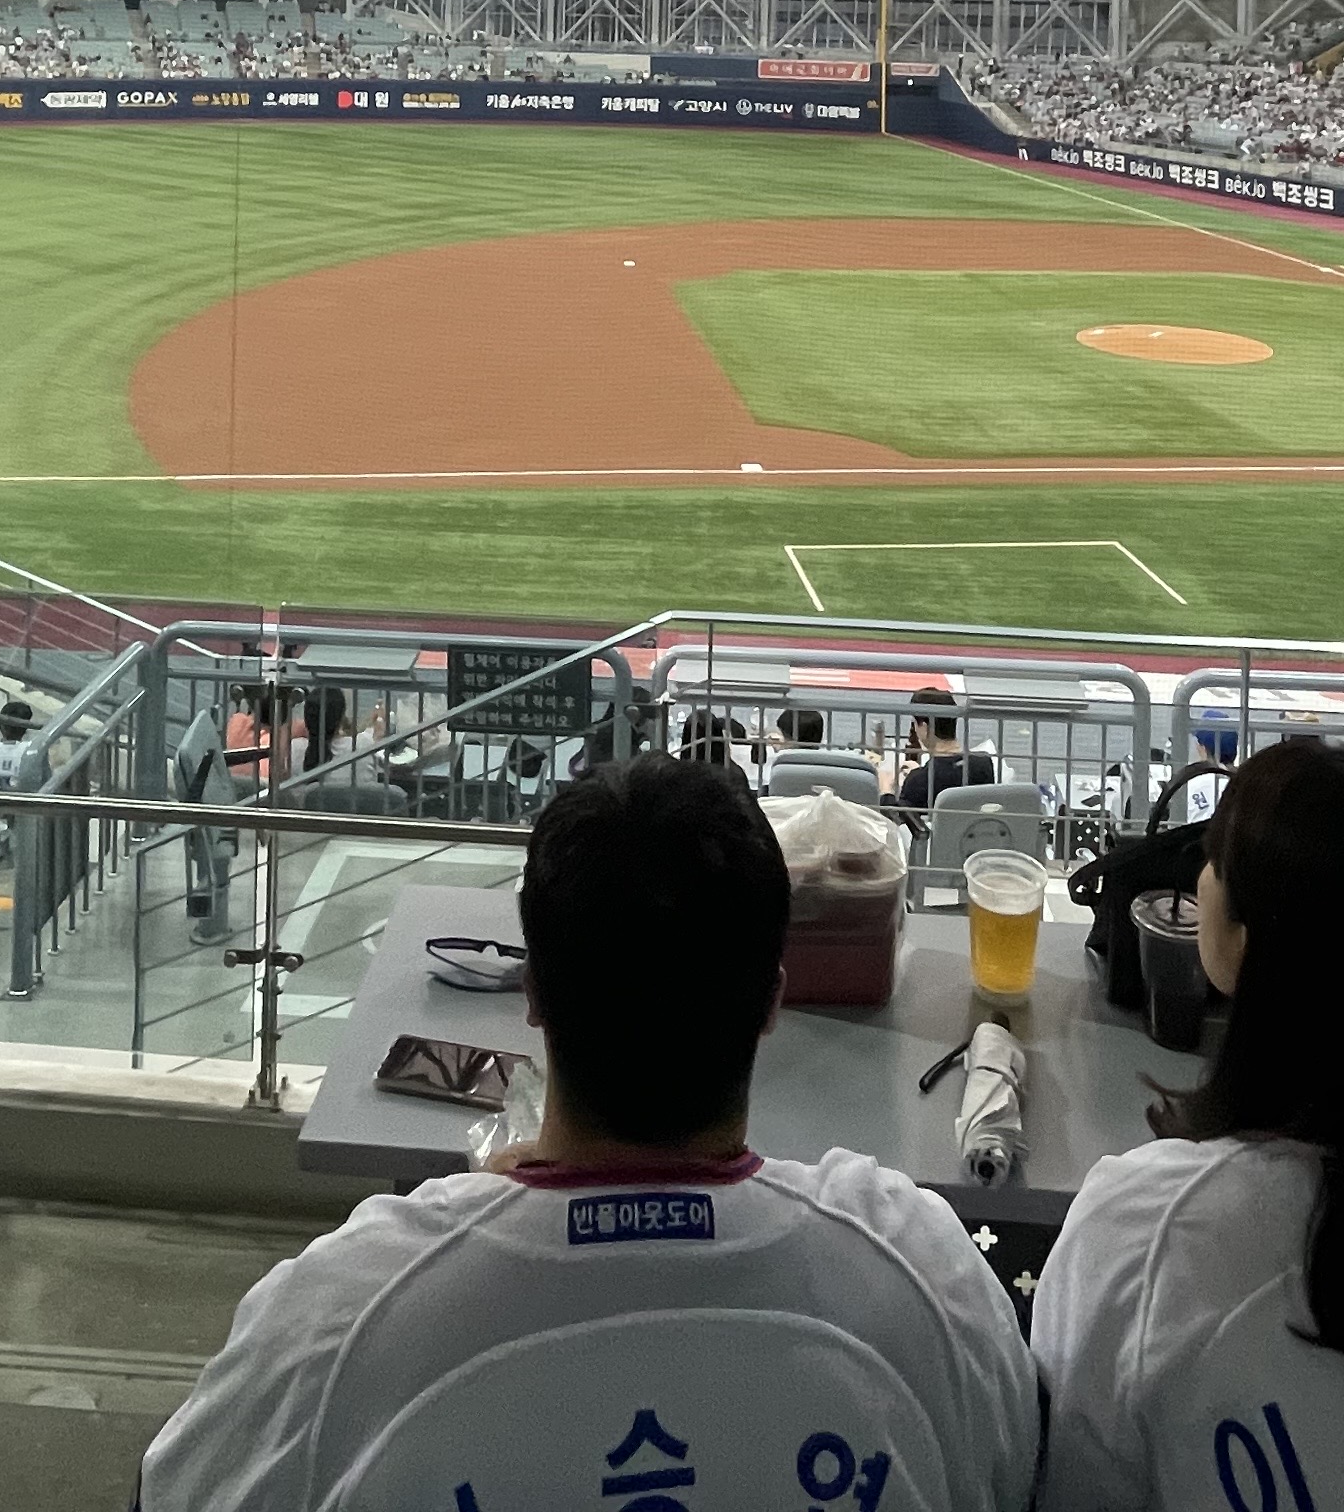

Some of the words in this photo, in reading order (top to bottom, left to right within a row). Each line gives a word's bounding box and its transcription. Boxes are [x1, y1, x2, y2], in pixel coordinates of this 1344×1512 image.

[117, 91, 178, 105] GOPAX
[354, 91, 390, 109] 대원
[685, 100, 727, 113] 고양시
[1083, 150, 1125, 173] 백조씽크
[1168, 163, 1219, 189] 백조씽크
[1272, 180, 1335, 210] 백조씽크
[464, 652, 501, 668] 휠체어
